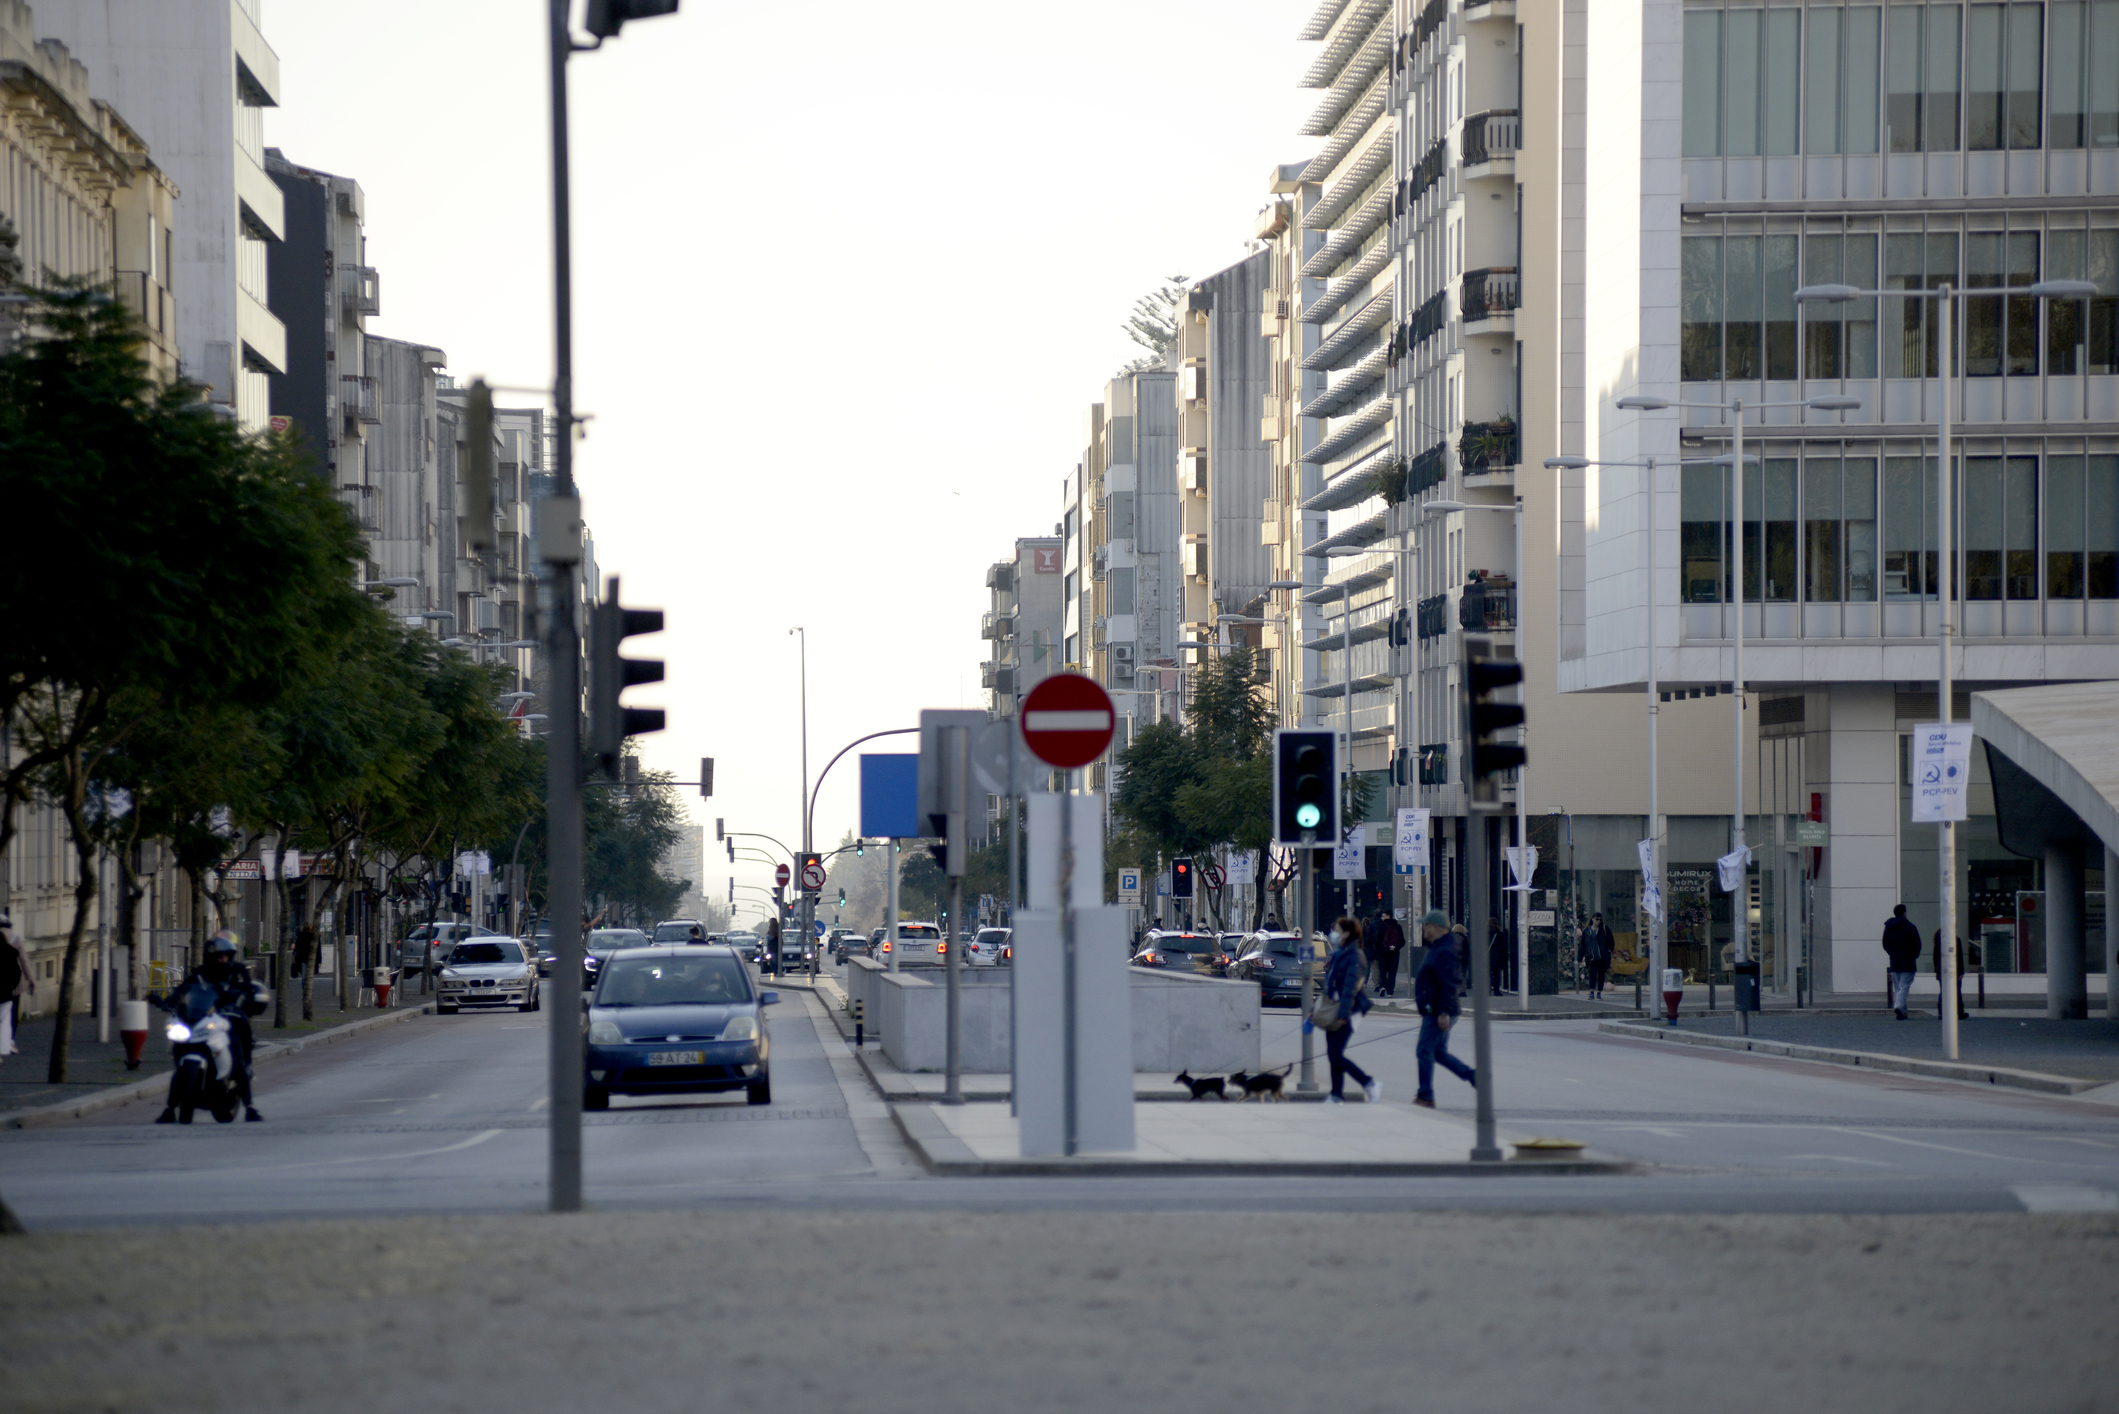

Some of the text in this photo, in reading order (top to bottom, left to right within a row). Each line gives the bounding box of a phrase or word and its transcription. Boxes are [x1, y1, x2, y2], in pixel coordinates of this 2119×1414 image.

[1929, 733, 1947, 741] CDU
[1923, 788, 1958, 796] PCP-PEV
[1125, 876, 1134, 888] P
